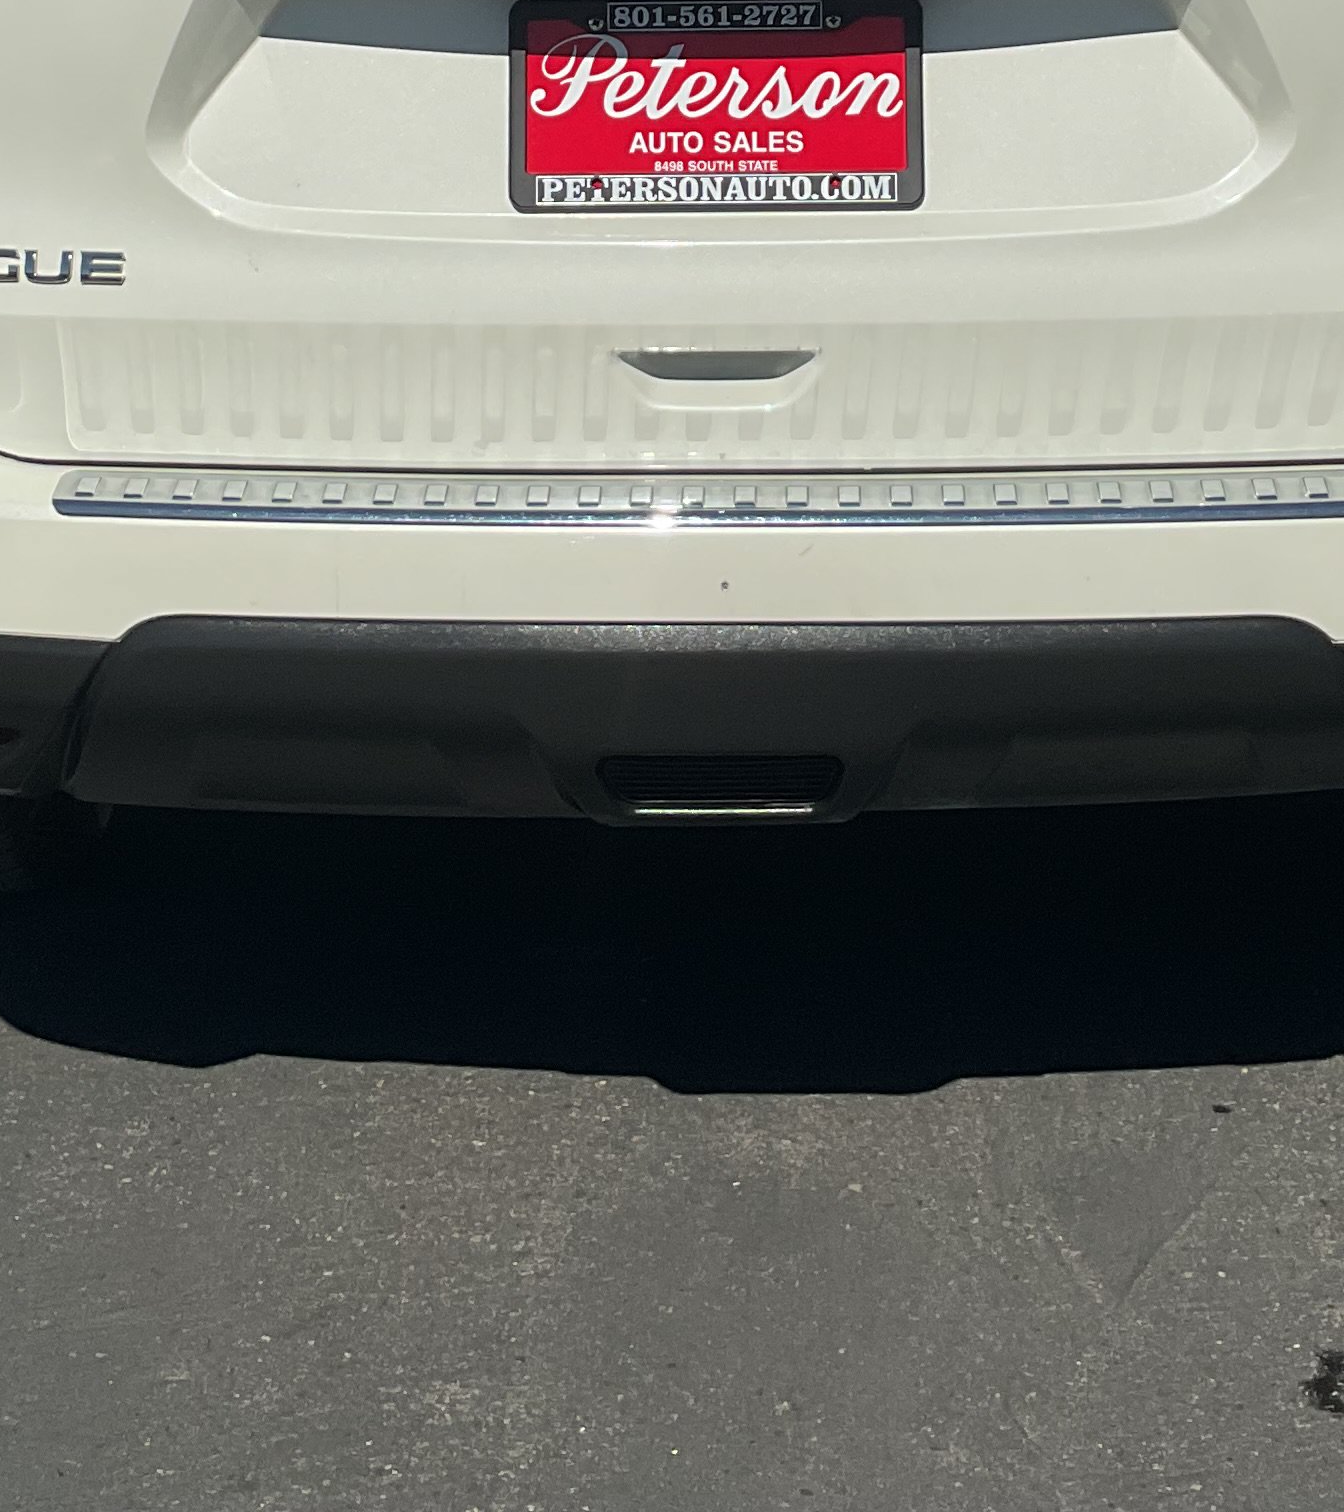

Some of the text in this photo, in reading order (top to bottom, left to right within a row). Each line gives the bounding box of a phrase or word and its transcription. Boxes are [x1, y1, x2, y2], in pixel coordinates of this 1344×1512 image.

[613, 4, 817, 27] 801-561-2727
[530, 34, 904, 121] Peterson
[628, 130, 805, 154] AUTO SALES
[654, 159, 779, 172] 8498 SOUTH STATE
[542, 174, 892, 203] PETERSONAUTO.COM
